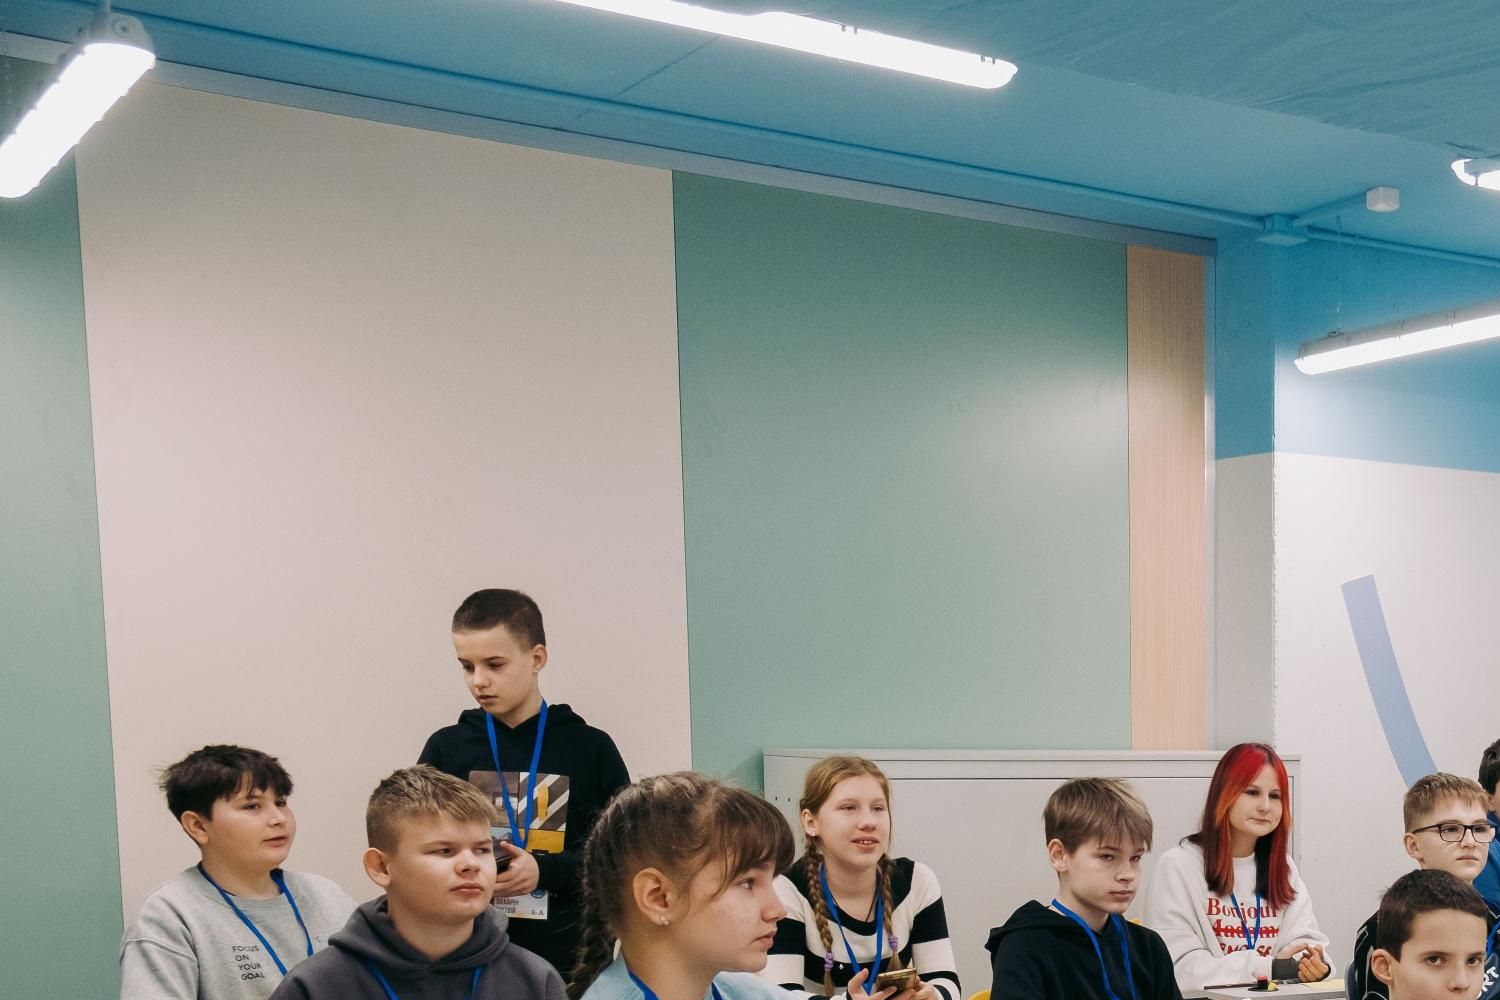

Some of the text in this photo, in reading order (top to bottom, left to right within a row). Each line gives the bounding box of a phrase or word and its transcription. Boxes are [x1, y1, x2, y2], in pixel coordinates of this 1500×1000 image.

[237, 963, 262, 971] YOUR
[241, 972, 265, 981] GOAL
[1477, 966, 1500, 999] RT
